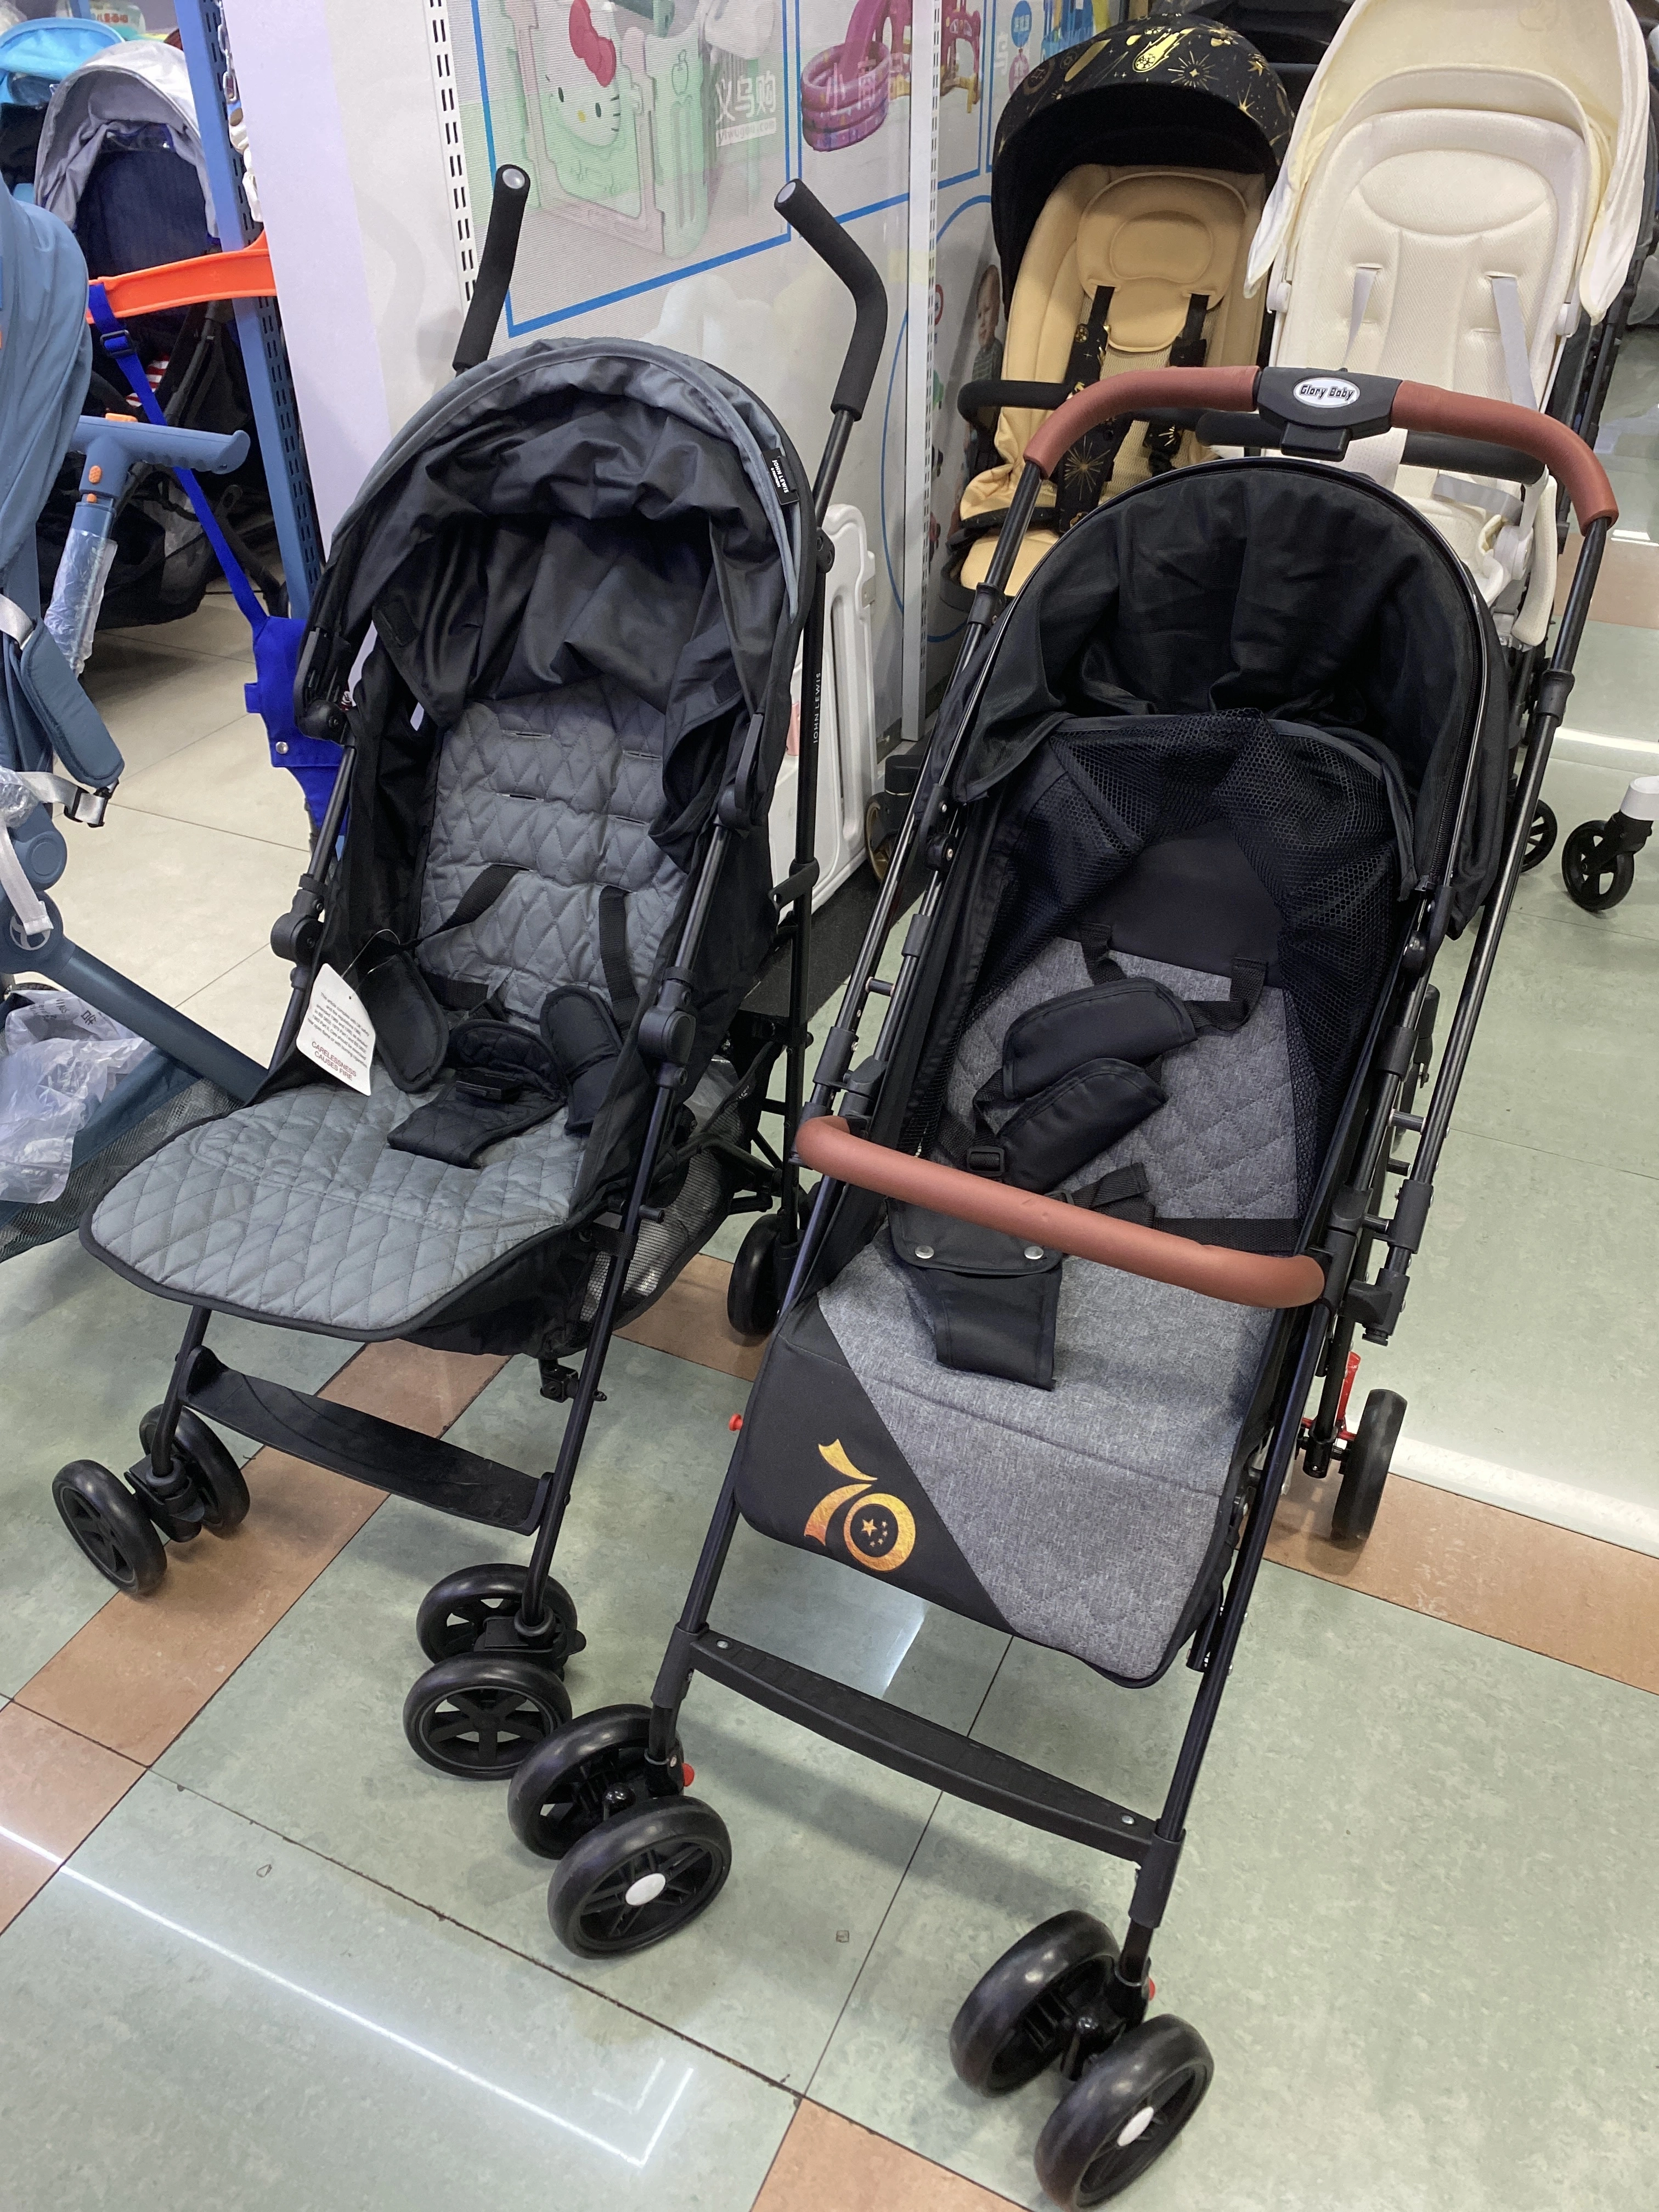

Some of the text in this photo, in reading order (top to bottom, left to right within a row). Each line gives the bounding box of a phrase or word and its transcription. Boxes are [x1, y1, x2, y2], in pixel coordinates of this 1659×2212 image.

[715, 70, 776, 124] 义乌购
[1300, 385, 1355, 400] Glory Baby
[772, 460, 789, 493] JOHN LEWIS
[312, 1041, 357, 1077] CARELESSNESS
[314, 1051, 353, 1081] CAUSES FIRE
